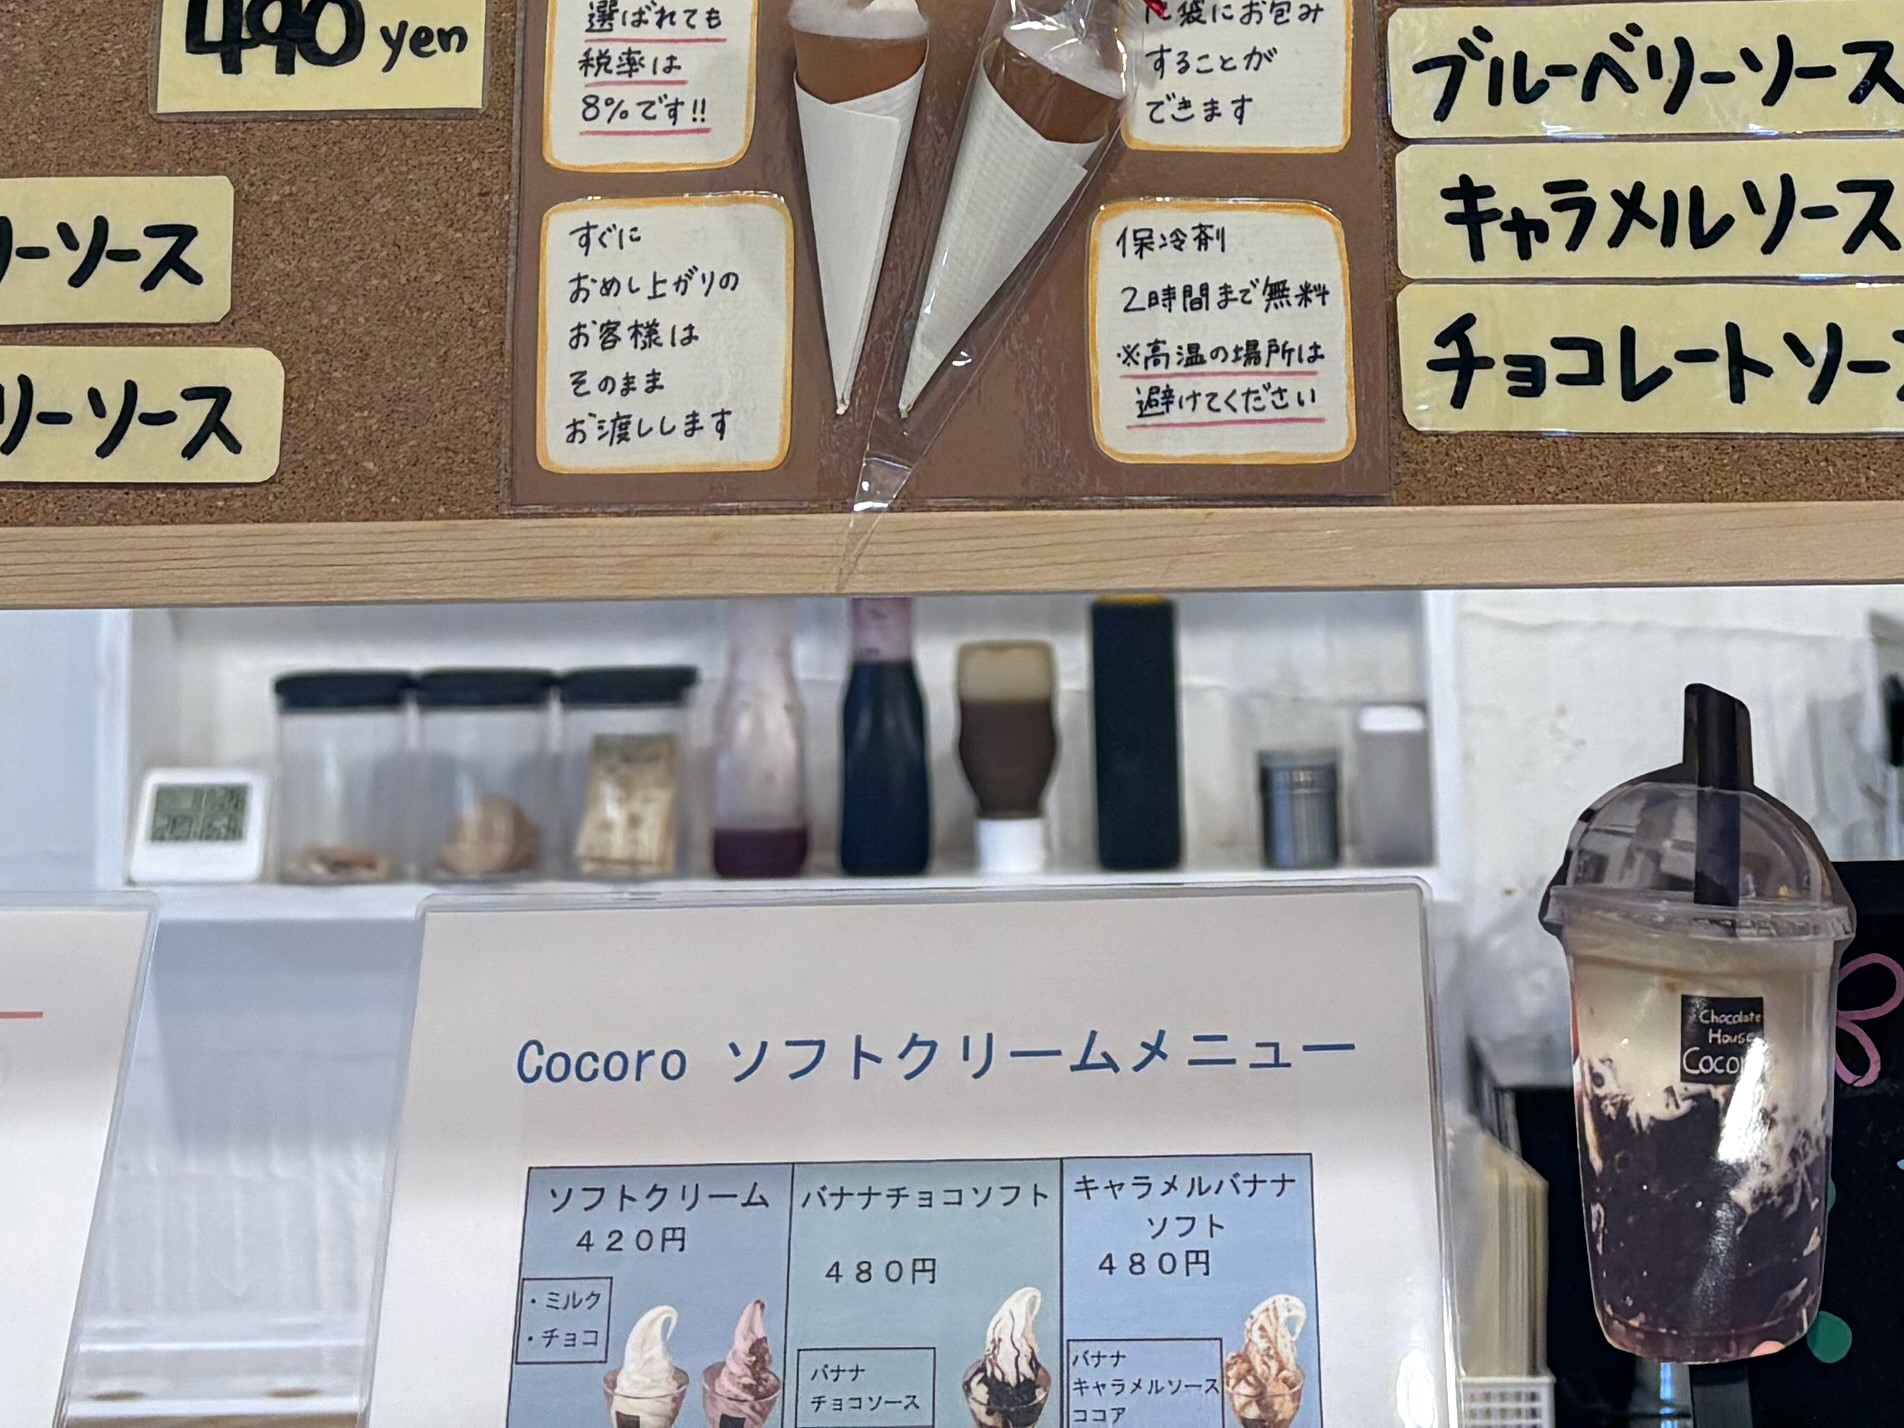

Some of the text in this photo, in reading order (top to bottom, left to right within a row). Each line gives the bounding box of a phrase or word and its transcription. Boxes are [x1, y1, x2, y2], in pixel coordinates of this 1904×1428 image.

[585, 0, 723, 34] 選ばれても
[578, 47, 681, 79] 税率は
[1144, 45, 1279, 79] することが
[580, 94, 707, 126] 8%です!!
[1145, 94, 1254, 126] できます
[1439, 173, 1902, 263] キャラメルソース
[569, 221, 642, 257] すぐに
[1115, 223, 1226, 260] 保冷剤
[568, 265, 740, 304] おめし上がりの
[1122, 275, 1331, 313] 2時間まで無料
[568, 320, 700, 351] お客様は
[569, 369, 666, 398] そのまま
[1135, 383, 1317, 418] 避けてください
[565, 408, 733, 446] お渡しします
[1699, 1009, 1761, 1025] Chocolate
[517, 1027, 1358, 1087] Cocoro ソフトクリームメニュー
[1683, 1047, 1746, 1074] Coco
[549, 1182, 770, 1214] ソフトクリーム
[801, 1182, 1049, 1210] バナナチョコソフト
[1073, 1172, 1297, 1201] キャラメルバナナ
[1147, 1213, 1226, 1240] ソフト
[810, 1364, 866, 1383] バナナ
[1072, 1349, 1127, 1368] バナナ
[1072, 1377, 1221, 1396] キャラメルソース
[810, 1393, 920, 1413] チョコソース
[1073, 1406, 1126, 1424] ココア
